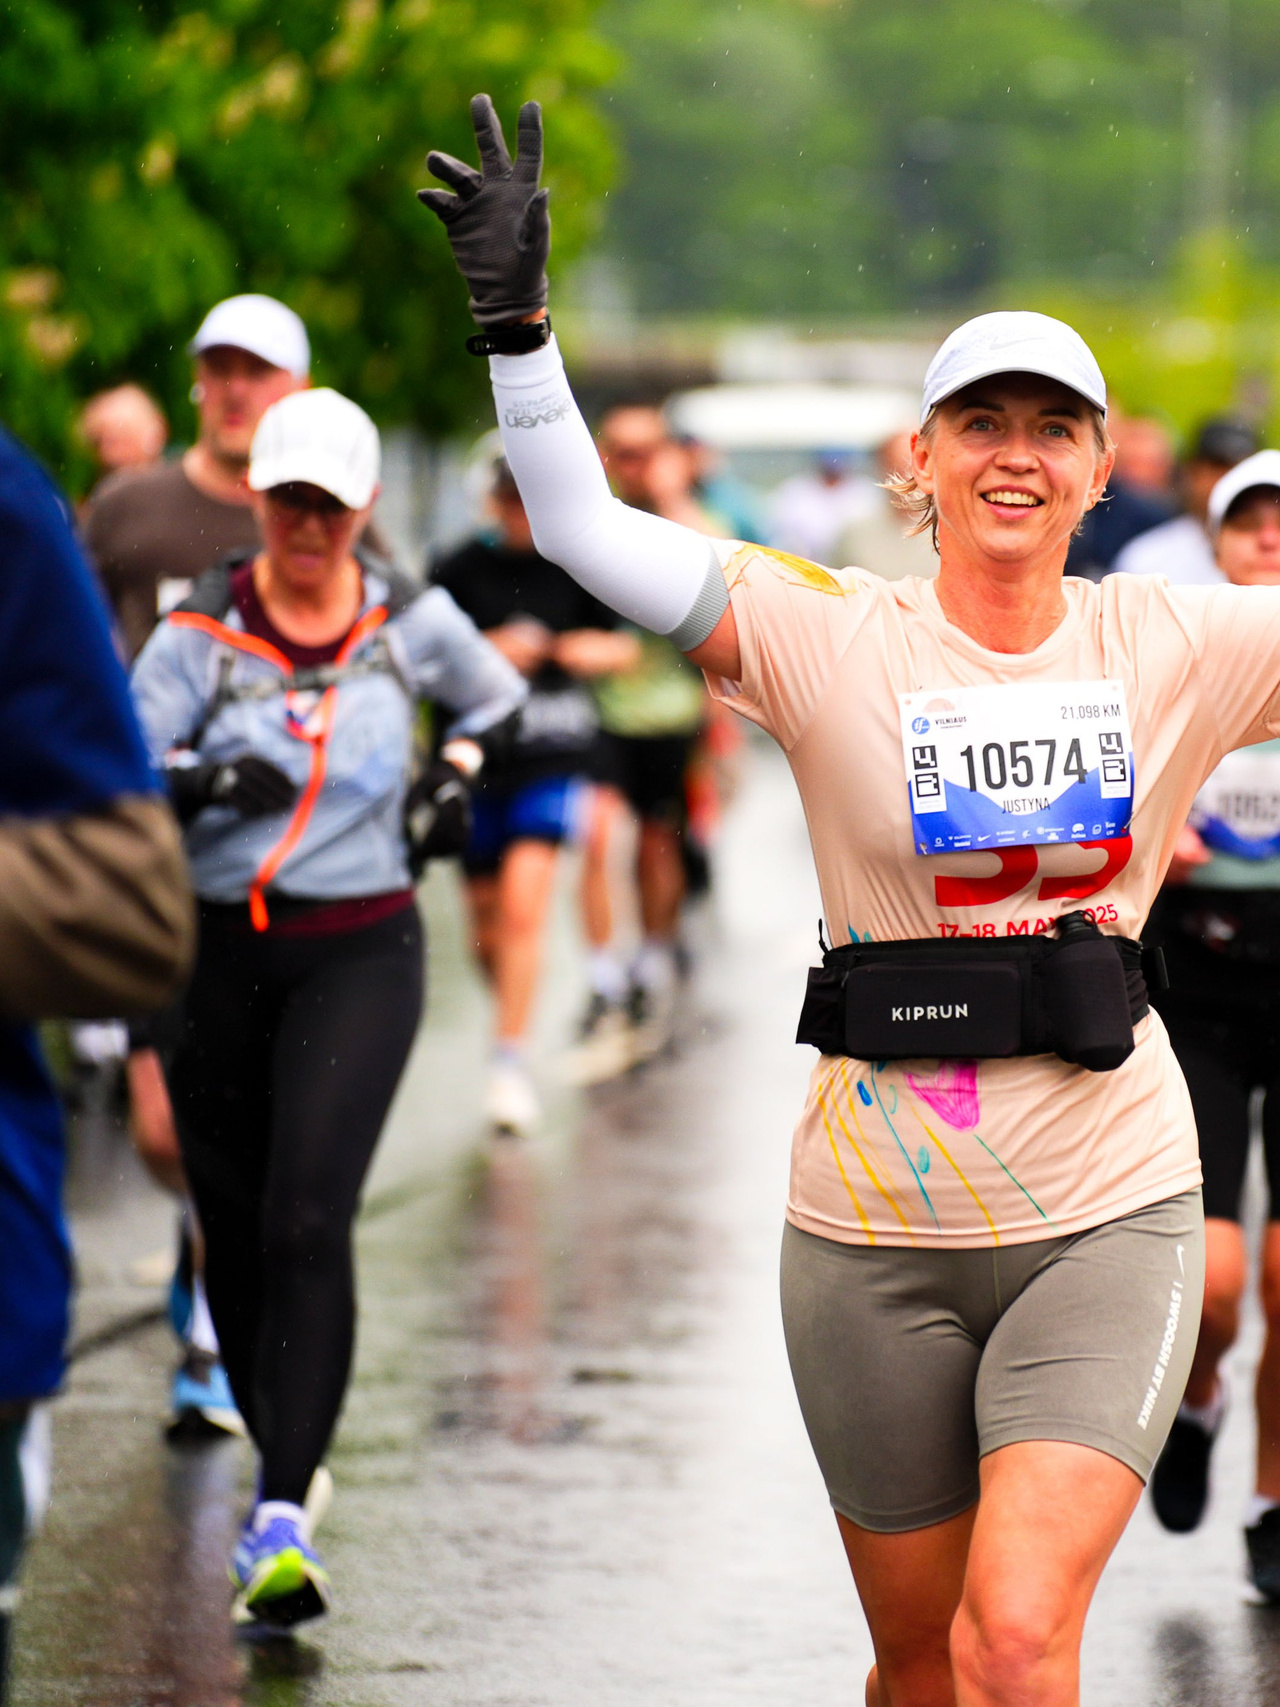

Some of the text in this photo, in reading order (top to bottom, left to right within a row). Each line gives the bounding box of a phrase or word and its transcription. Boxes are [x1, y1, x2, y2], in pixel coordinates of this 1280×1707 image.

[934, 716, 967, 725] VILNIAUS
[1103, 703, 1121, 717] KM
[960, 738, 1088, 792] 10574
[1002, 797, 1051, 814] JUSTYNA
[1080, 904, 1119, 925] 025
[891, 1003, 968, 1021] KIPRUN
[1158, 1289, 1182, 1367] SWOOSH
[1152, 1363, 1166, 1391] BY
[1137, 1385, 1158, 1431] NIKE
